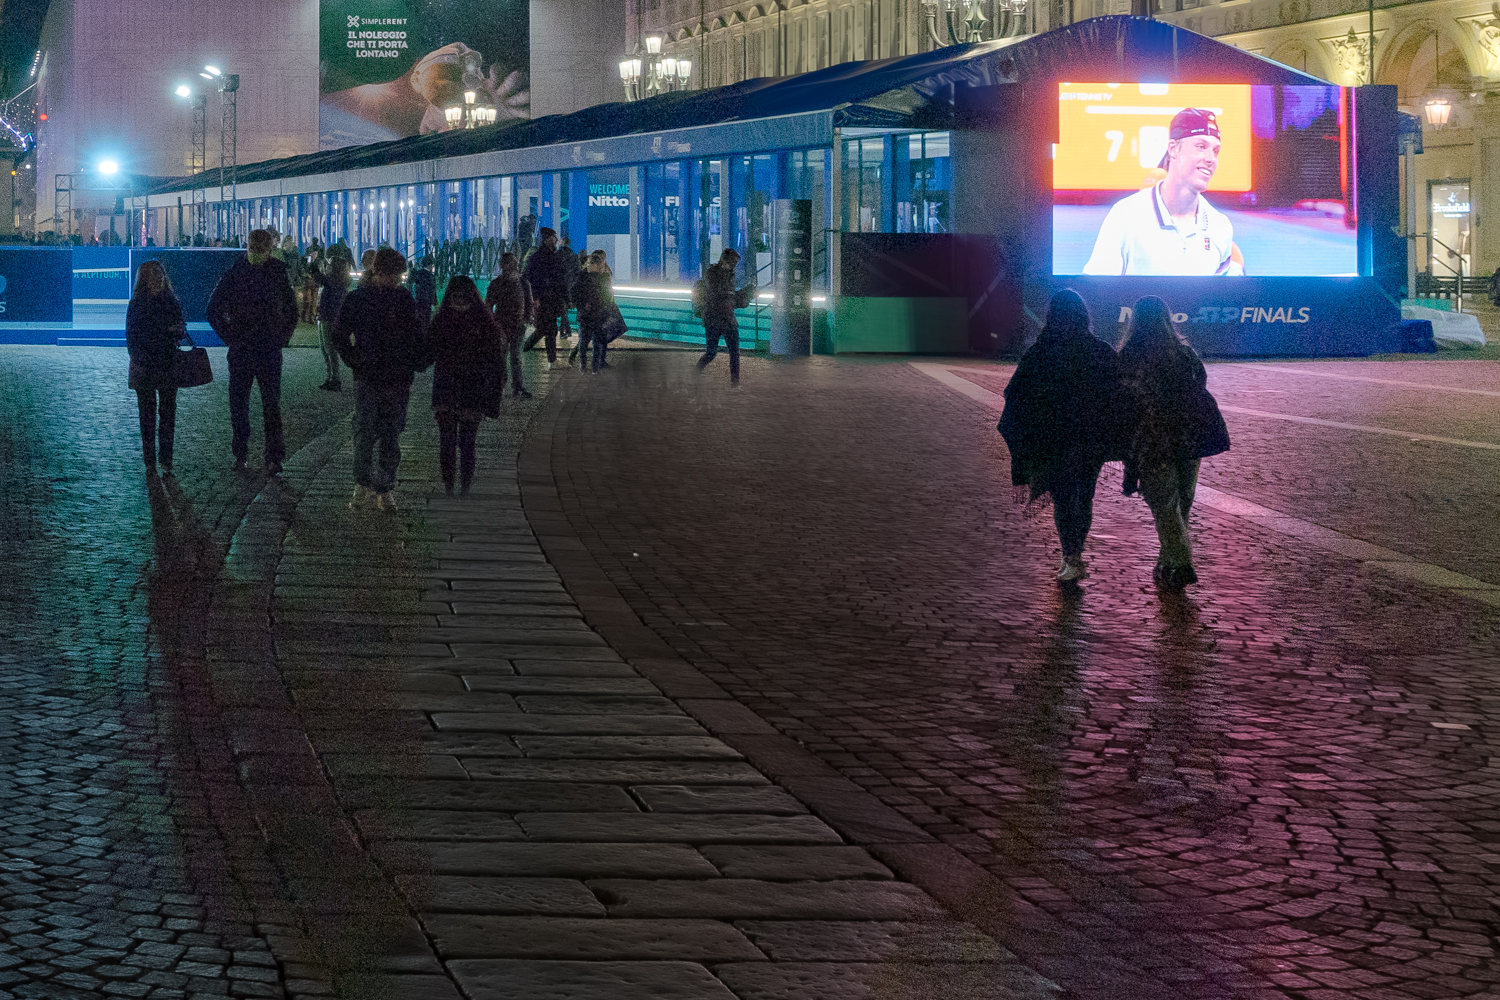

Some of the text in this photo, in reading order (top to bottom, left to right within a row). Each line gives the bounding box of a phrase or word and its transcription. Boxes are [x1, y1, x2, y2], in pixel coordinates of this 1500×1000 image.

[348, 31, 407, 39] IL NOLEGGIO
[356, 50, 399, 58] LONTANO
[1105, 131, 1124, 162] 7
[590, 184, 630, 194] WELCOME
[588, 195, 629, 207] Nitto
[1240, 307, 1310, 323] FINALS
